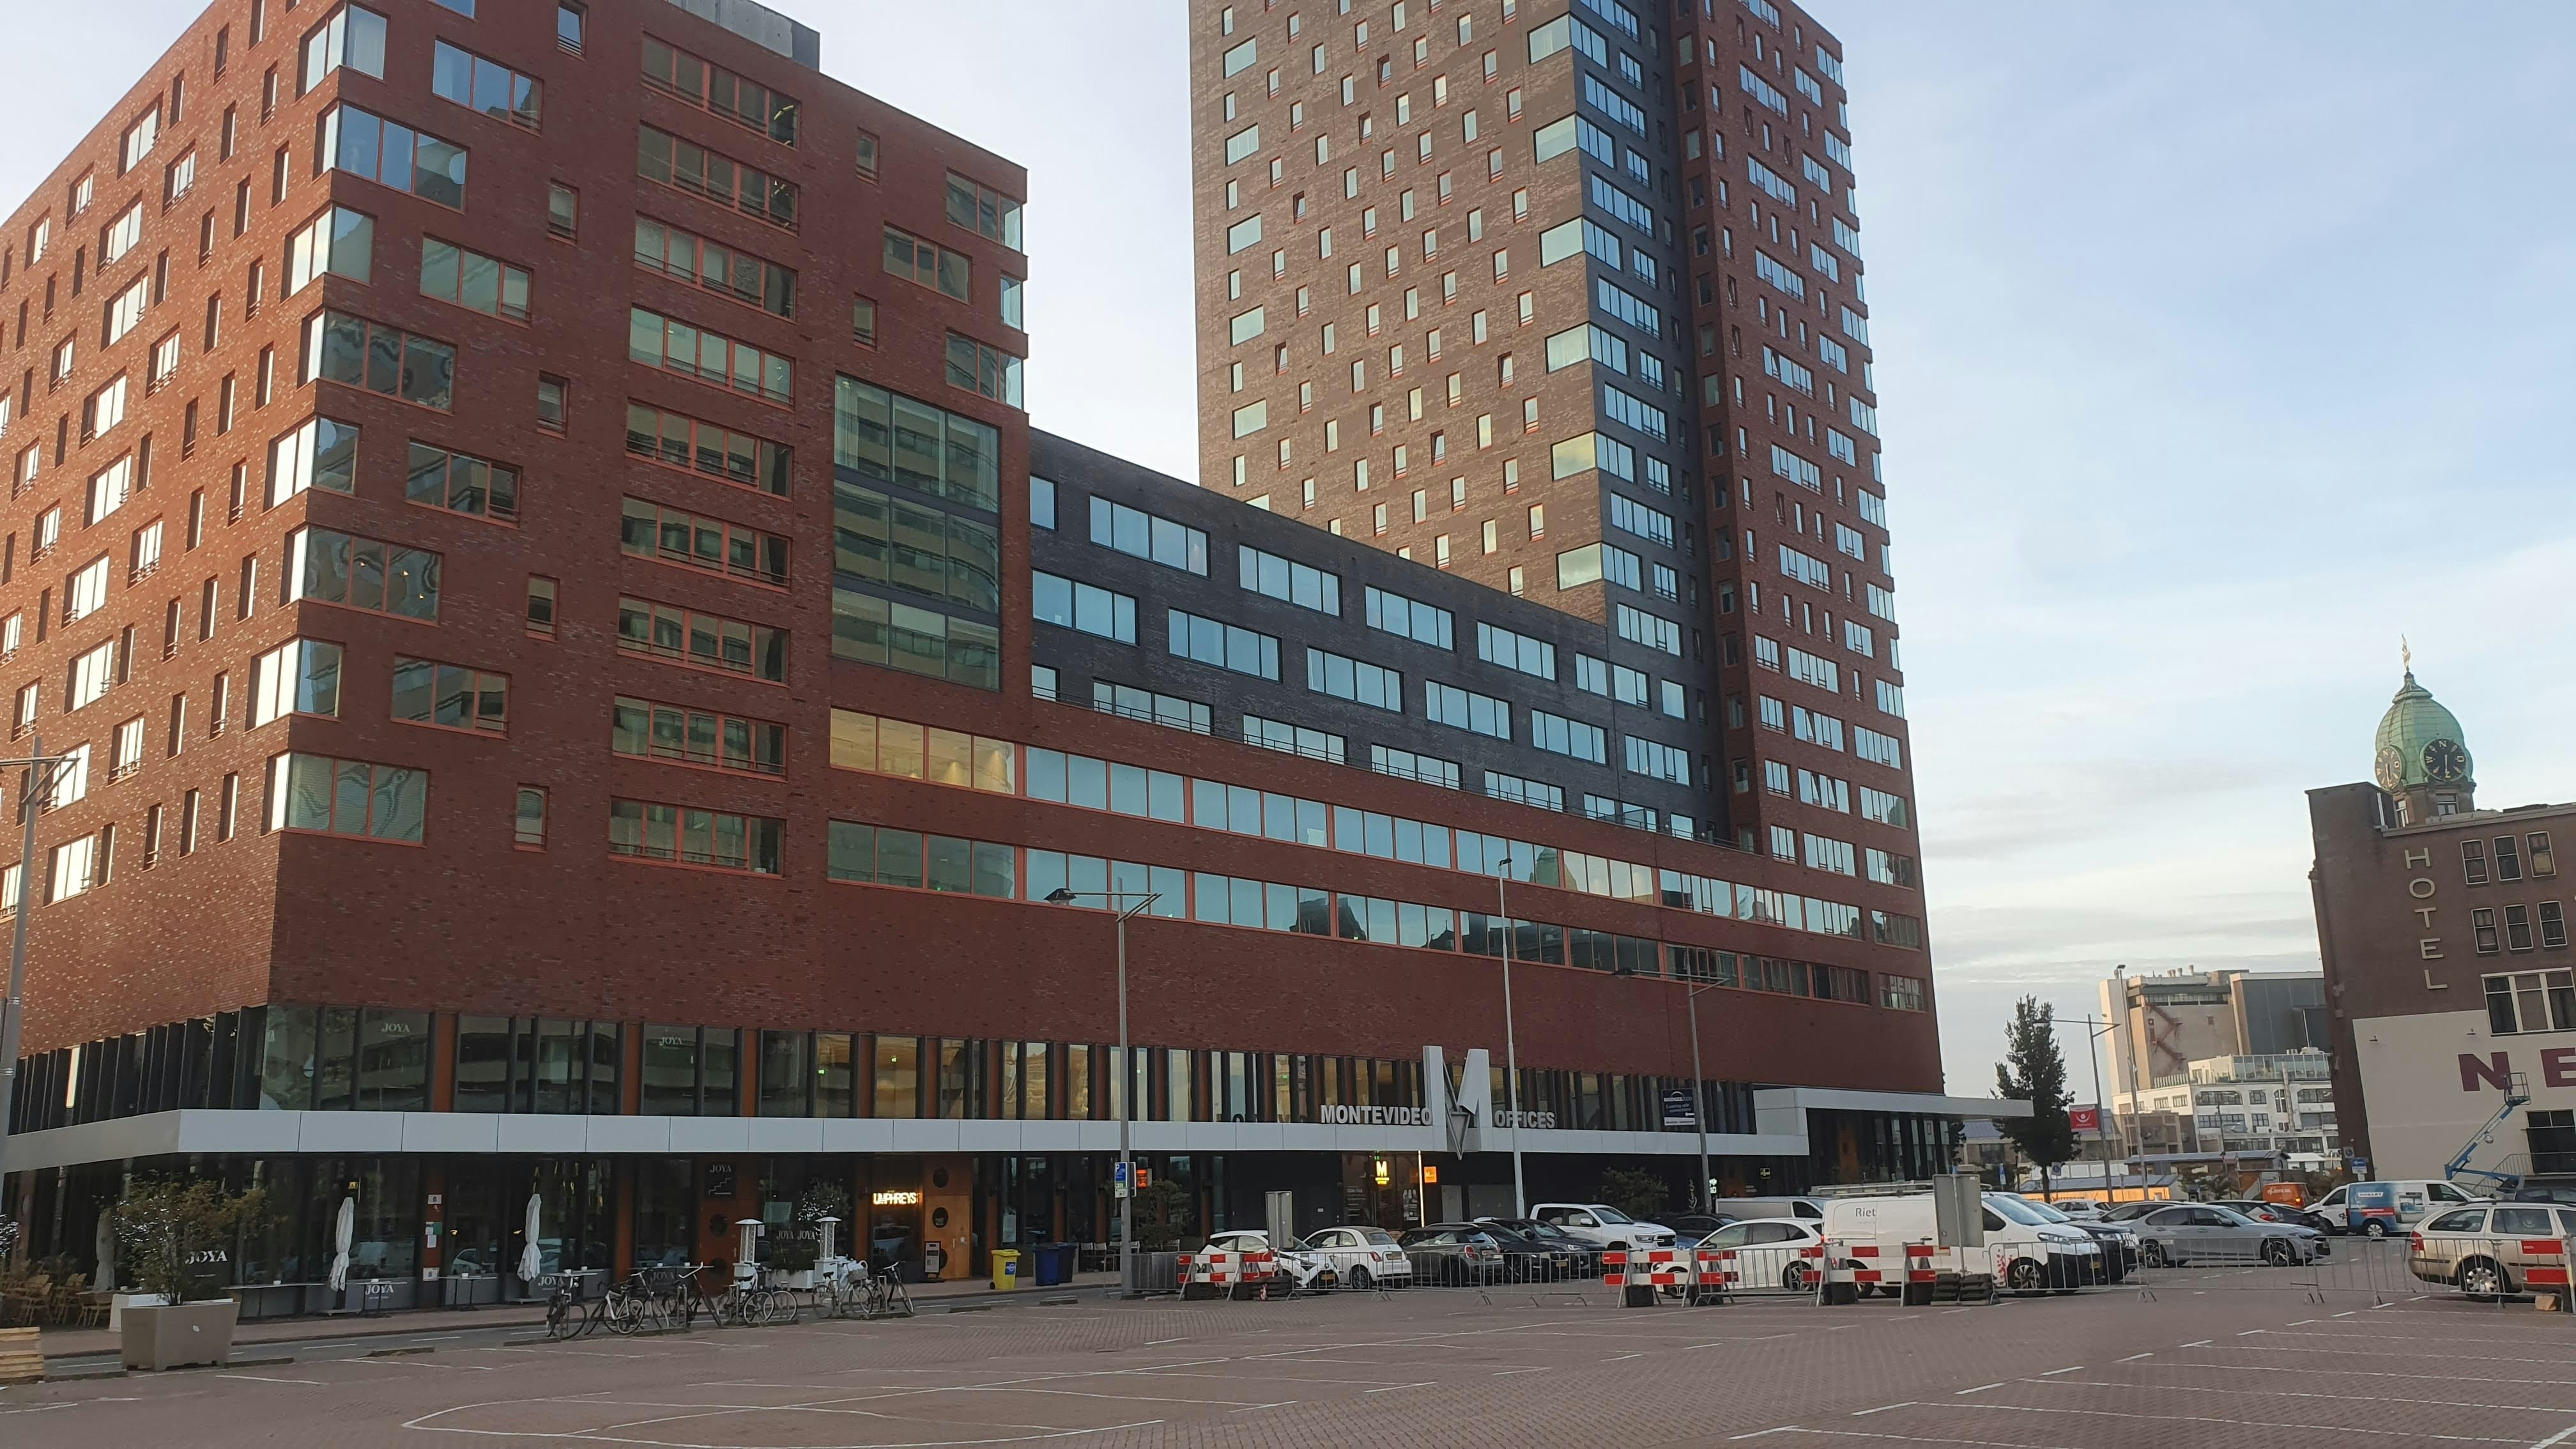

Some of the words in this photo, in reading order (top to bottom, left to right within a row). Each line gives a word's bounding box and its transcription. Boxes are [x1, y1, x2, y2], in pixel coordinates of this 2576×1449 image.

[2404, 847, 2448, 990] HOTEL
[381, 1022, 410, 1032] JOYA
[659, 1036, 683, 1046] JOYA
[2458, 1047, 2576, 1091] NE
[1321, 1104, 1432, 1126] MONTEVIDEO
[1494, 1110, 1556, 1129] OFFICES
[710, 1165, 732, 1173] JOYA
[1116, 1164, 1120, 1172] P
[1376, 1160, 1388, 1177] M
[1855, 1208, 1876, 1217] Riet
[776, 1230, 794, 1239] JOYA
[797, 1230, 815, 1240] JOYA
[185, 1250, 227, 1264] JOYA
[538, 1276, 565, 1286] JOYA
[365, 1284, 394, 1295] JOYA
